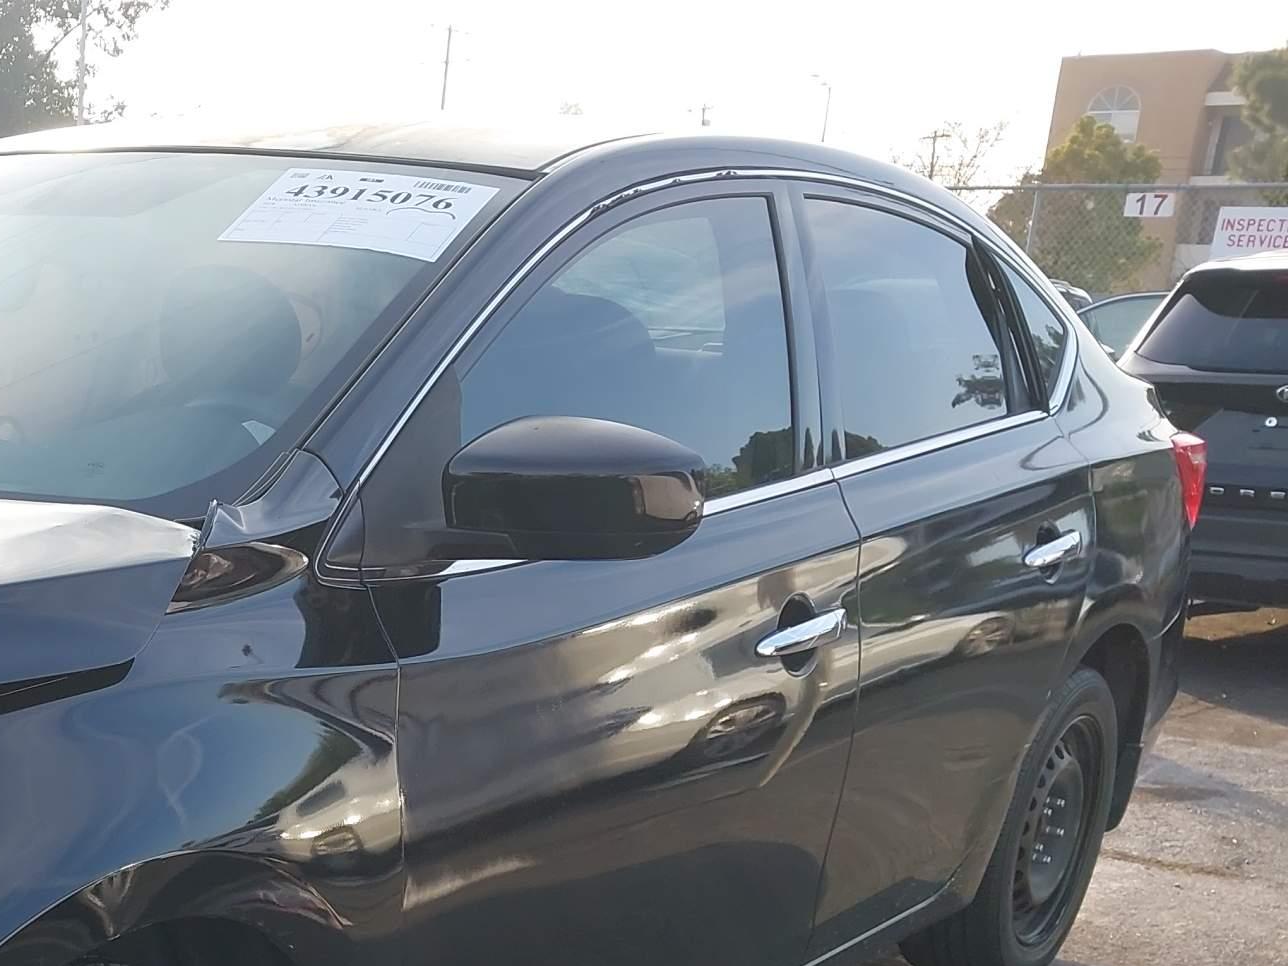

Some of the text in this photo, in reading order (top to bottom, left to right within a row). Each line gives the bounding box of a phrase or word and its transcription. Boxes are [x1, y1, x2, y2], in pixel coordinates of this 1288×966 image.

[285, 183, 459, 211] 43915076
[1135, 194, 1169, 216] 17
[1221, 218, 1288, 233] INSPECT
[1226, 233, 1288, 249] SERVICE
